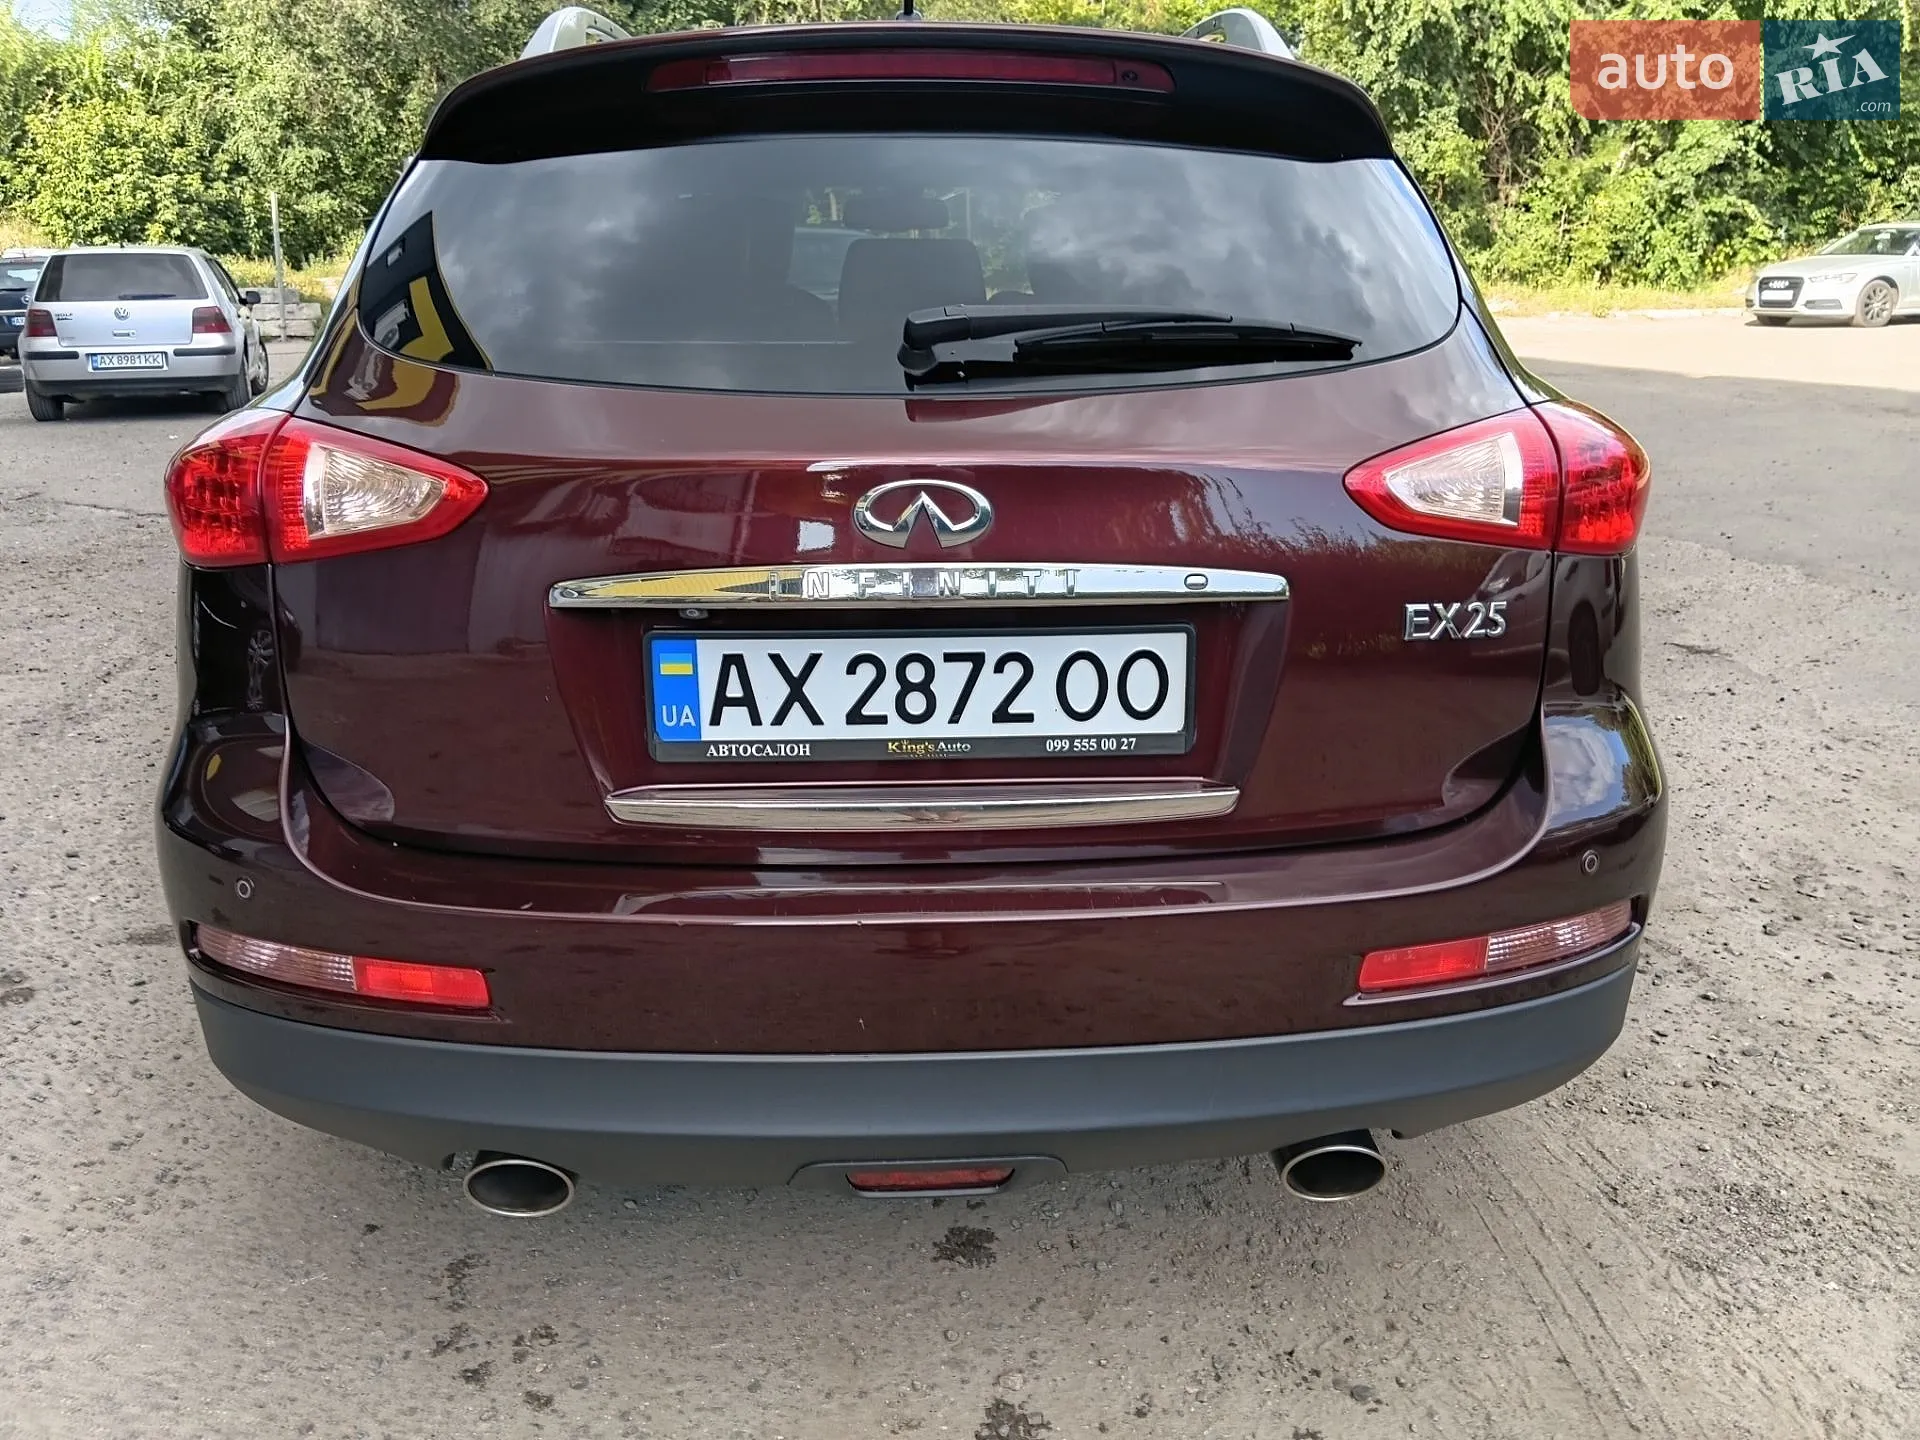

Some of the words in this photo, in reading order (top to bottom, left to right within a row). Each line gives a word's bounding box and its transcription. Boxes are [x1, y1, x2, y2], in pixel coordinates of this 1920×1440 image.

[99, 355, 115, 366] AX
[116, 355, 142, 365] 8981
[144, 354, 161, 365] KK
[768, 569, 1081, 600] INFINITI
[1404, 601, 1507, 641] EX25
[708, 652, 825, 726] AX
[844, 651, 1035, 725] 2872
[1055, 648, 1170, 723] OO
[661, 704, 697, 728] UA
[706, 743, 811, 757] АВТОСАЛОН
[887, 740, 935, 754] King's
[936, 741, 972, 752] Auto
[1046, 739, 1070, 752] 099
[1073, 738, 1097, 751] 555
[1101, 738, 1117, 751] 00
[1120, 737, 1137, 750] 27
